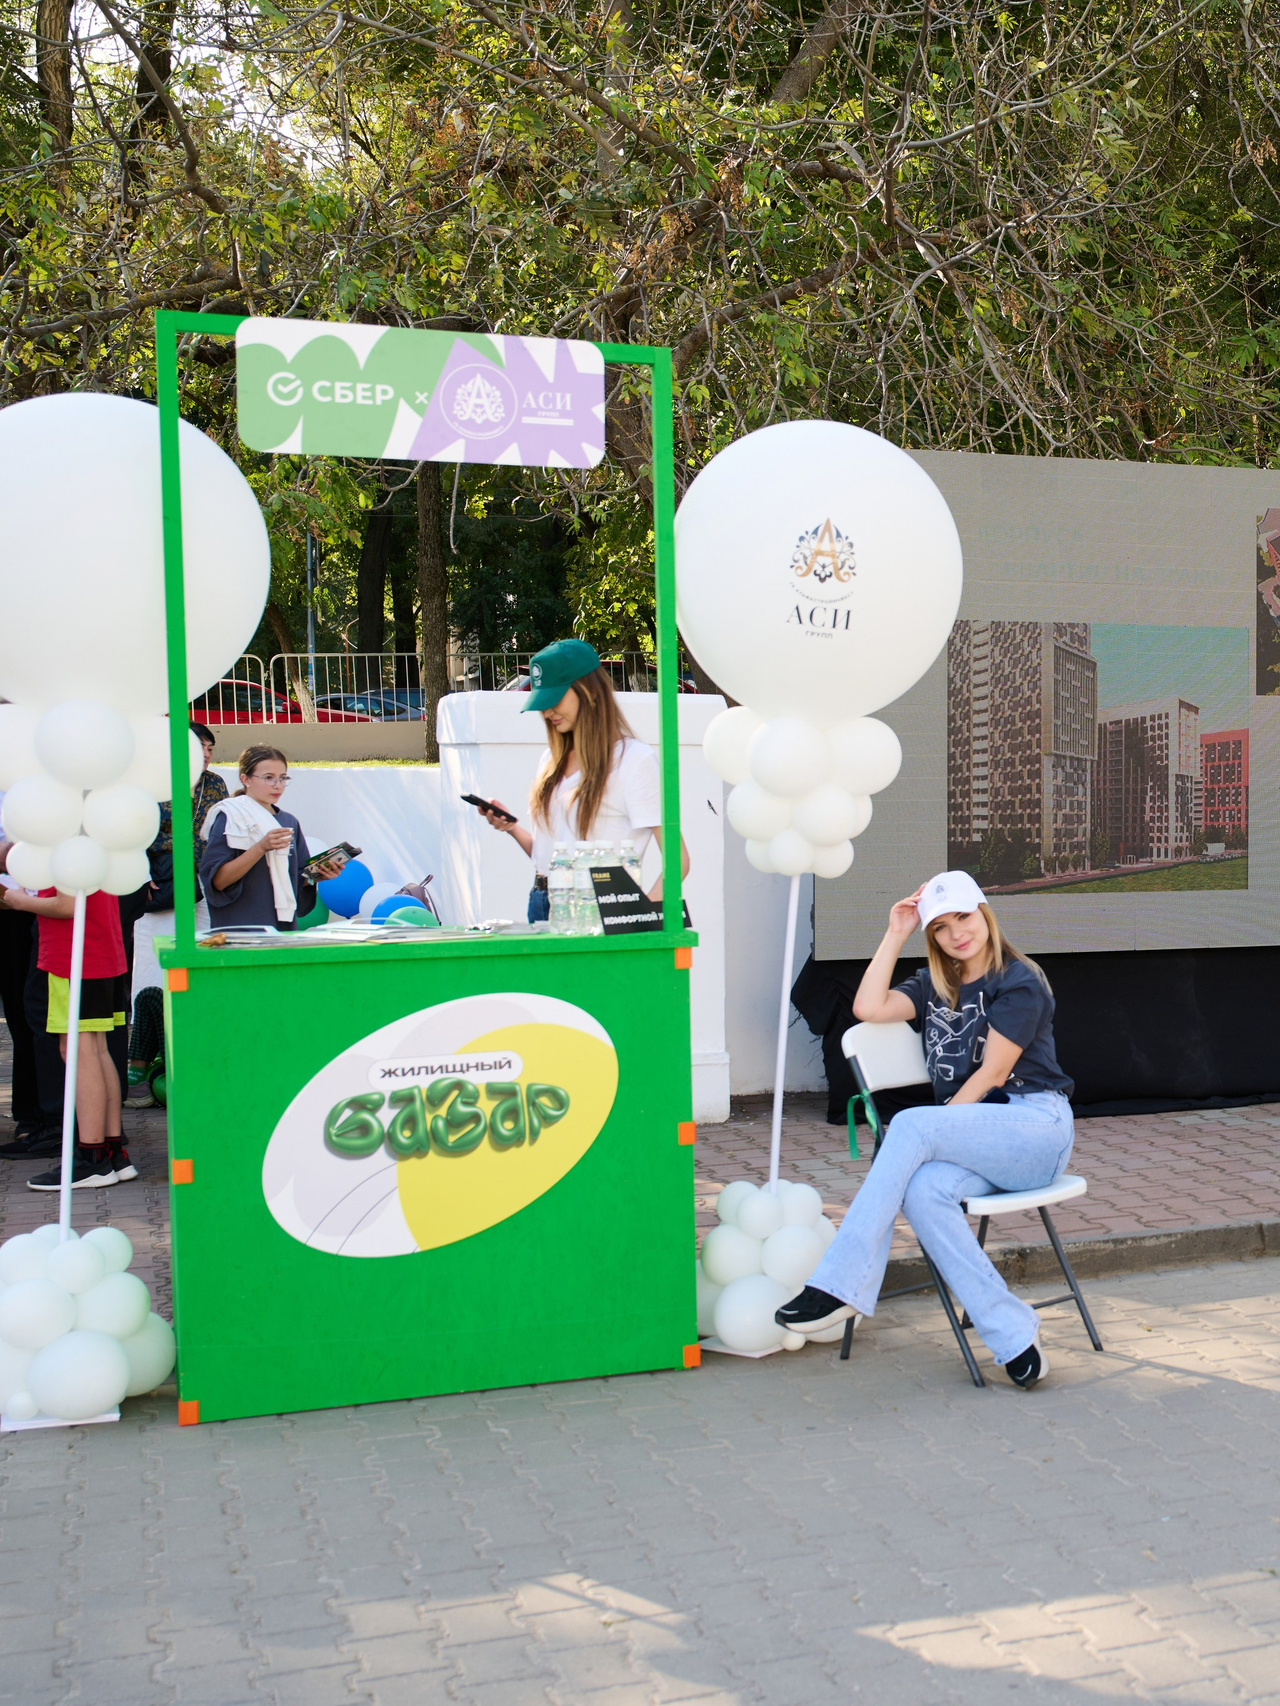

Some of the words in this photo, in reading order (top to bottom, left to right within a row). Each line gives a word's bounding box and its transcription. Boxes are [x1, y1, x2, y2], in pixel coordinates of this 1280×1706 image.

[312, 380, 394, 406] СБЕР
[522, 391, 573, 411] АСИ
[786, 603, 854, 631] АСИ
[598, 893, 617, 904] МОЙ
[617, 893, 640, 903] ОПЫТ
[603, 911, 658, 925] КОМФОРТНОЙ
[380, 1057, 512, 1079] ЖИЛИЩНЫЙ
